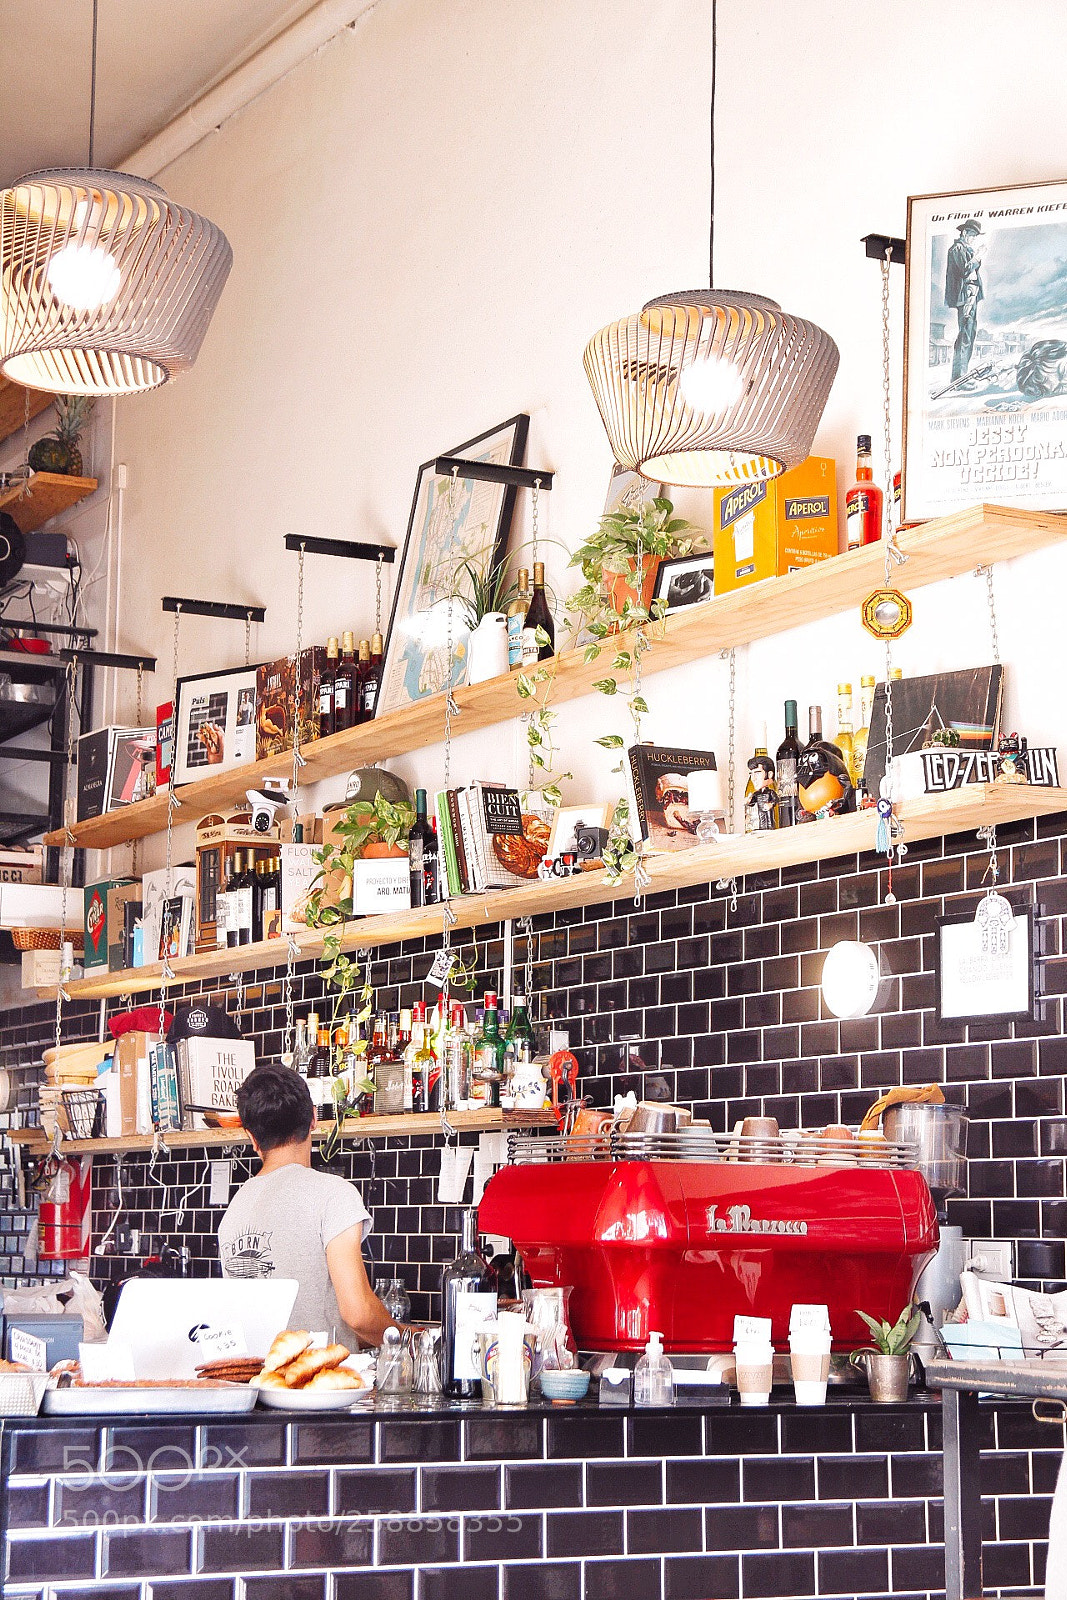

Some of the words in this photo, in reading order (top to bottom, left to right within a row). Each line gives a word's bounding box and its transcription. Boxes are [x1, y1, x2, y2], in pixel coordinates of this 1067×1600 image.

[931, 214, 945, 222] Un
[947, 212, 971, 220] Film
[988, 206, 1034, 218] WARREN
[1036, 202, 1067, 213] KIEFE
[928, 420, 944, 431] MARK
[946, 417, 970, 430] STEVENS
[1030, 411, 1050, 423] MARIO
[969, 424, 1028, 446] JESSY
[931, 448, 969, 468] NON
[973, 441, 1067, 464] PERDONA
[724, 481, 764, 522] APEROL
[788, 501, 827, 516] APEROL
[647, 753, 710, 766] HUCKLEBERRY
[920, 748, 1061, 794] LED-ZEPLIN
[630, 754, 646, 822] HUCKLEBERRY
[487, 792, 518, 805] BIEN
[487, 804, 518, 817] CUIT
[288, 867, 314, 876] SALT
[217, 1052, 237, 1066] THE
[210, 1066, 244, 1080] TIVOLI
[214, 1079, 241, 1093] ROAD
[211, 1092, 238, 1108] BAKE
[232, 1236, 260, 1256] BORN
